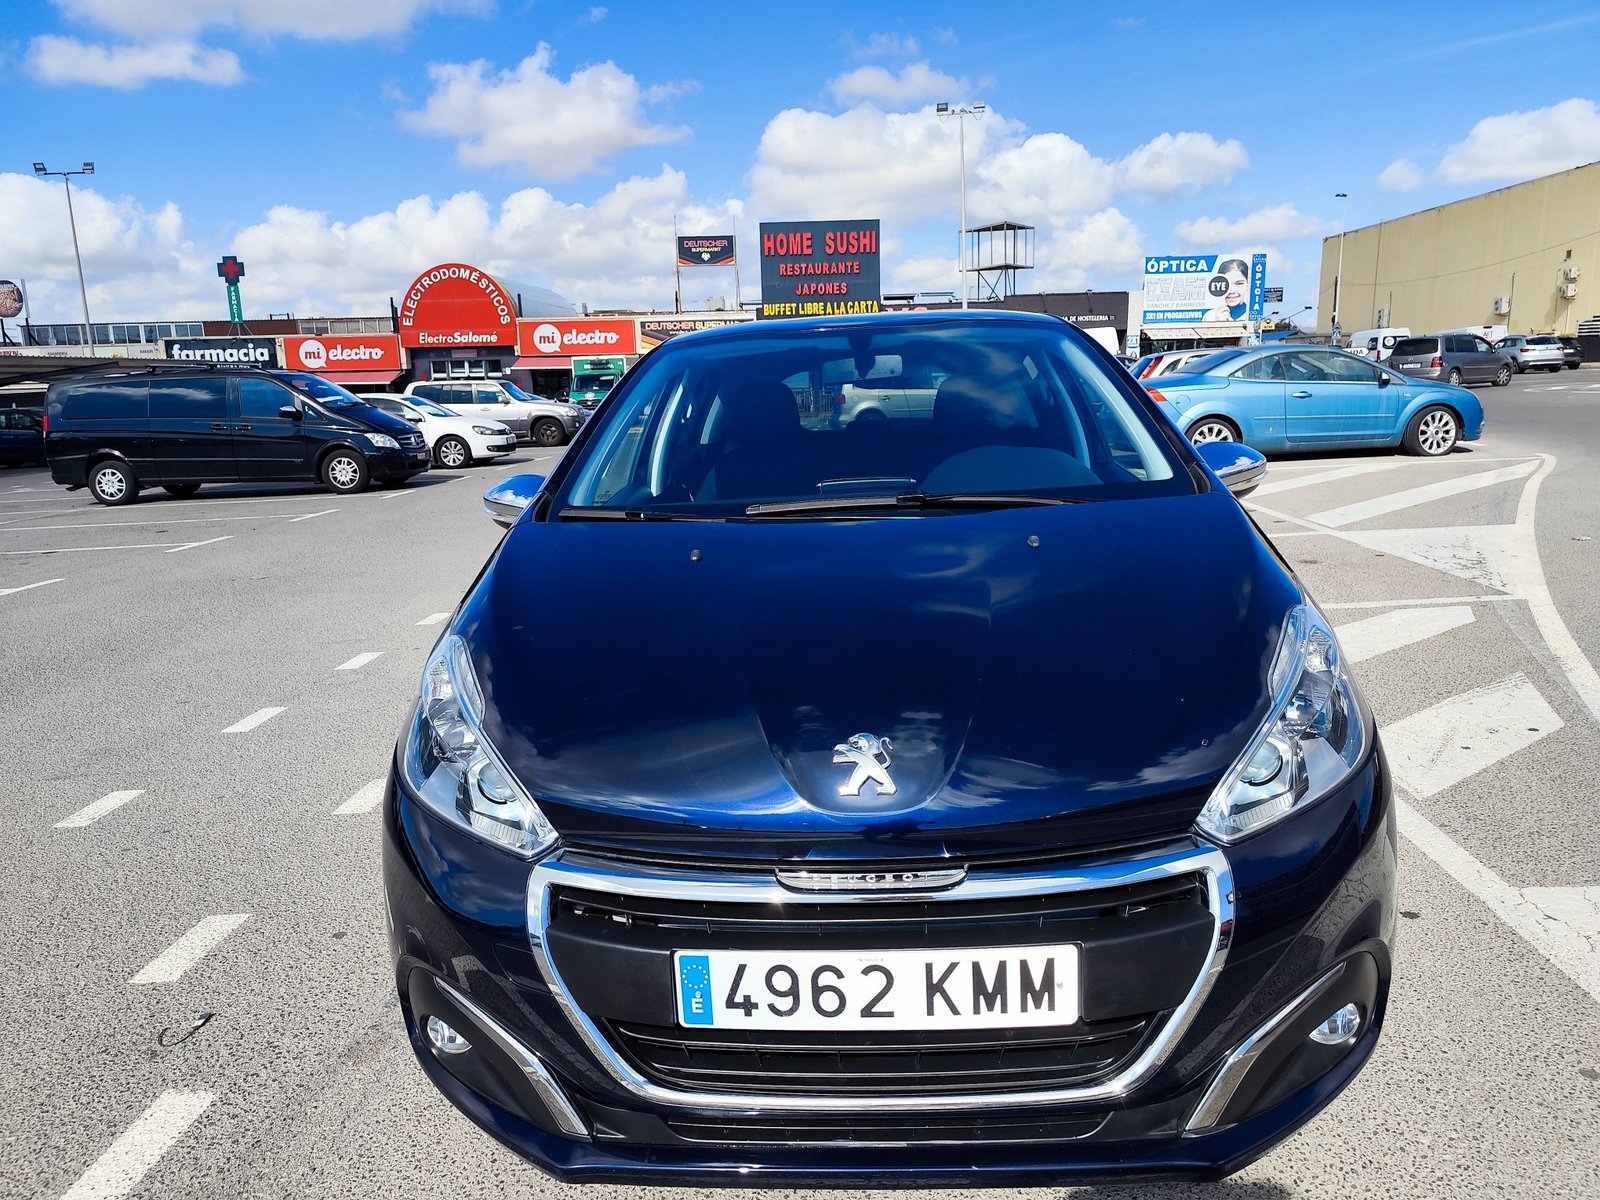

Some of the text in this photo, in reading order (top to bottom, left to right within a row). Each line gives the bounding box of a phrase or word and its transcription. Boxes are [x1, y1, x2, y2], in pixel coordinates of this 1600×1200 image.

[684, 240, 728, 248] DEUTSCHER
[763, 231, 876, 256] HOME SUSHI
[779, 262, 860, 275] RESTAURANTE
[1147, 259, 1208, 273] ÓPTICA
[796, 283, 847, 296] JAPONES
[1211, 284, 1226, 292] EYE
[402, 267, 511, 326] ELECTRODOMÉSTICOS
[230, 287, 240, 322] FARMACIA
[763, 303, 797, 316] BUFFET
[799, 304, 825, 315] LIBRE
[826, 304, 833, 315] A
[834, 303, 846, 315] LA
[847, 301, 879, 314] CARTA
[645, 322, 695, 331] DEUTSCHER
[419, 332, 498, 344] ElectroSalomé
[539, 329, 620, 345] mi electro
[172, 343, 270, 362] farmacia
[304, 344, 385, 361] mi electro
[725, 957, 1056, 1019] 4962 KMM
[691, 998, 704, 1014] E
